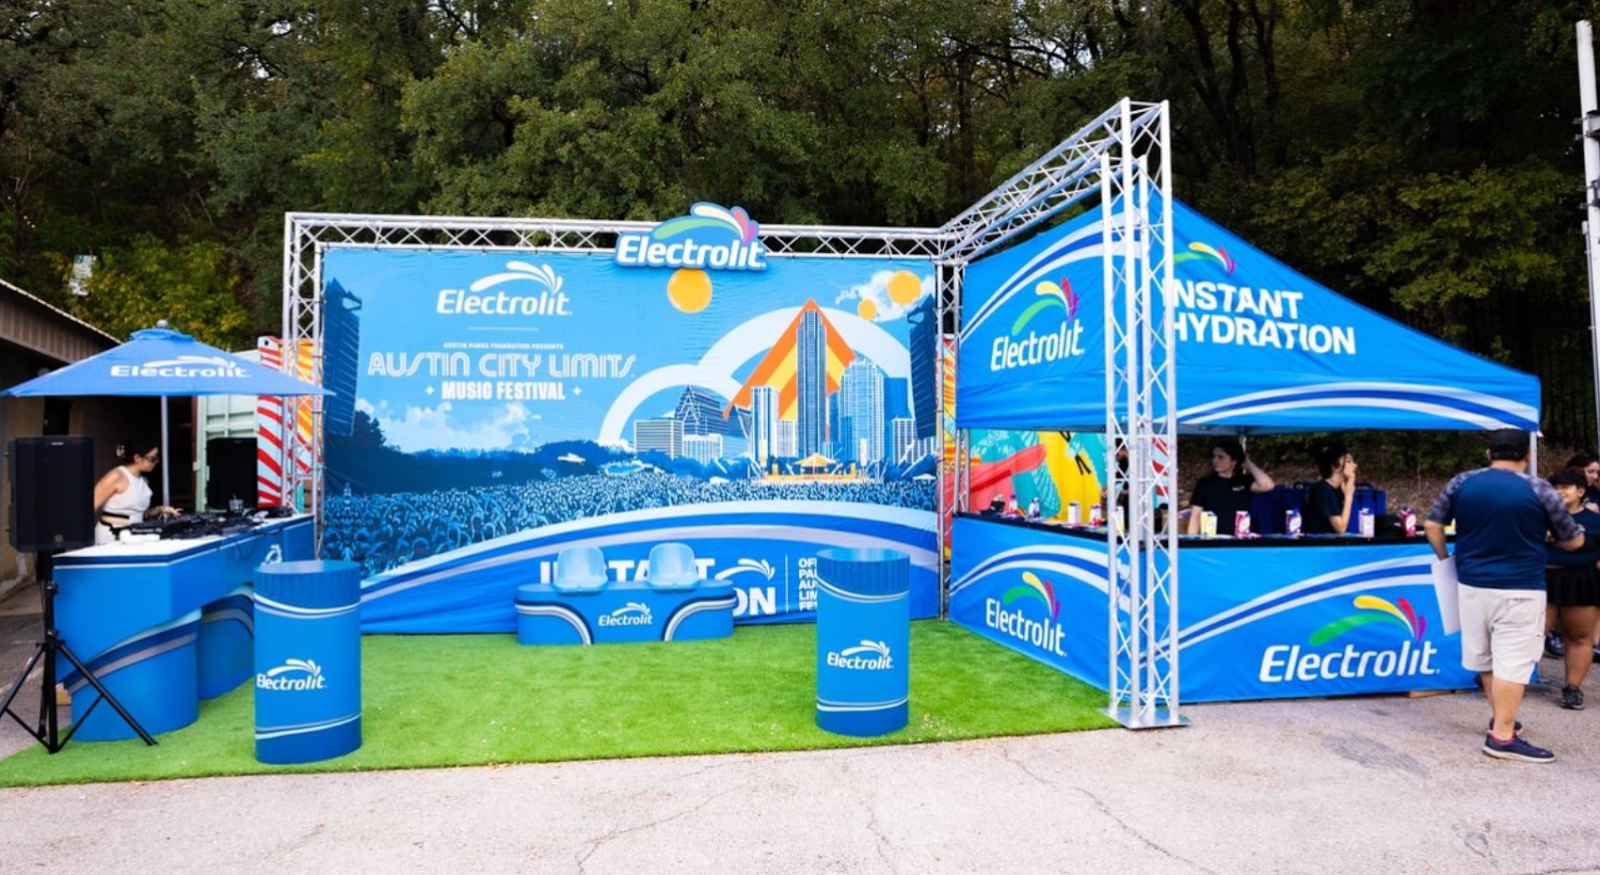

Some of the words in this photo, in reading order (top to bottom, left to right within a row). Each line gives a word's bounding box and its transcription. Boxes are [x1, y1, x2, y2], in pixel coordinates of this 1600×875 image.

[616, 234, 766, 268] Electrolit
[436, 289, 572, 316] Electrolit
[991, 319, 1084, 371] Electrolit
[110, 365, 251, 378] Electrolit
[367, 351, 471, 377] AUSTIN
[478, 352, 541, 377] CITY
[549, 353, 637, 378] LIMITS
[441, 381, 492, 399] MUSIC
[497, 382, 566, 400] FESTIVAL
[598, 614, 653, 626] Electrolit
[986, 598, 1068, 657] Electrolit
[827, 652, 894, 670] Electrolit
[1259, 640, 1440, 682] Electrolit
